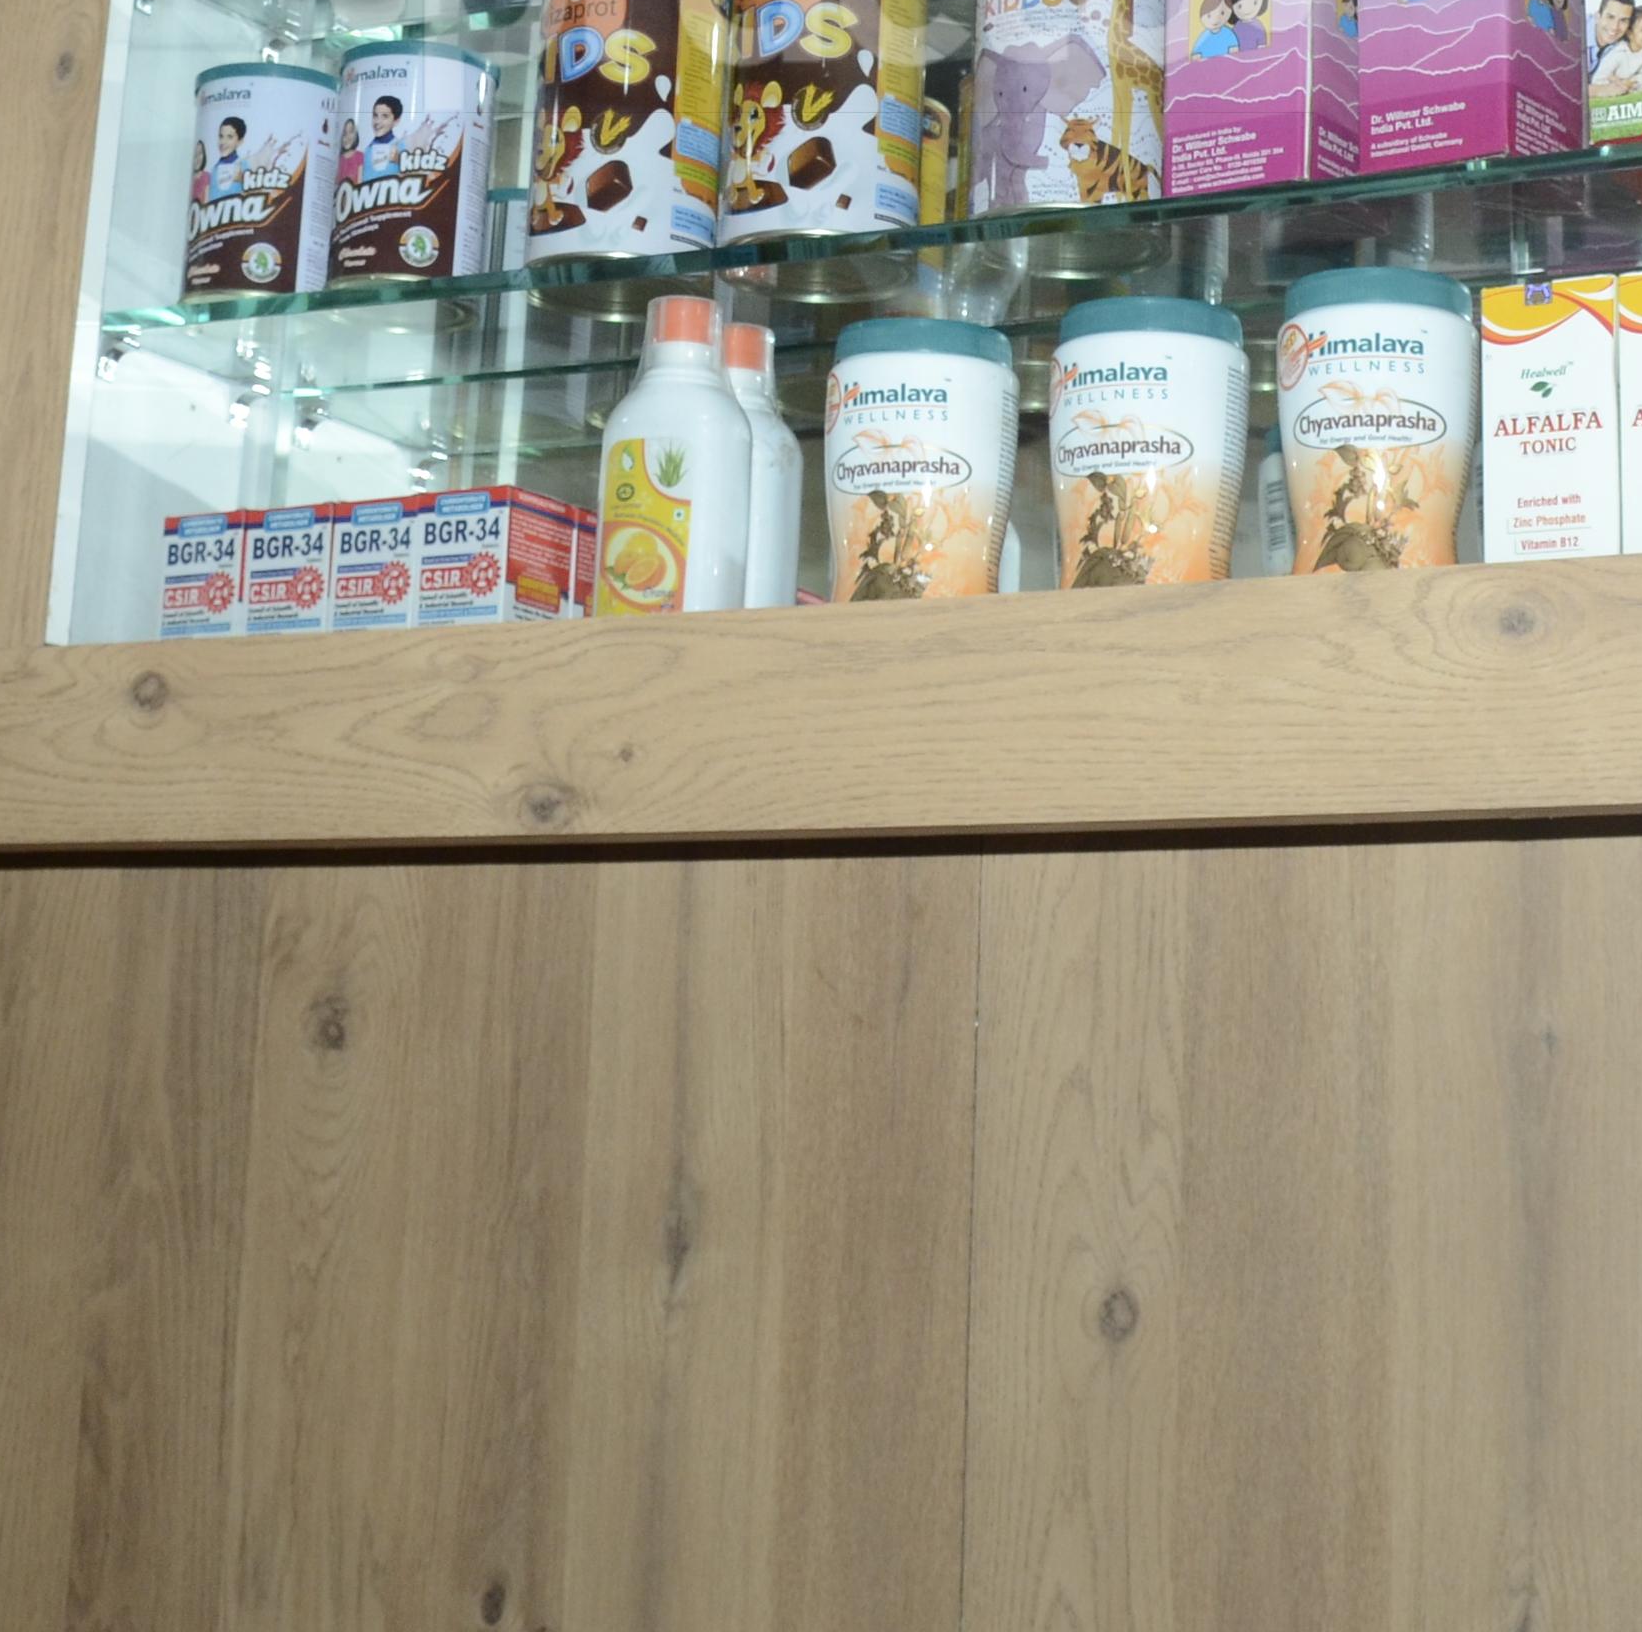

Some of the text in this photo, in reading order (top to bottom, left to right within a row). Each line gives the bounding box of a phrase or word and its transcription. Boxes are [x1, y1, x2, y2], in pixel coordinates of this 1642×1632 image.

[400, 149, 448, 172] kidz
[243, 168, 291, 190] kidz
[1308, 331, 1424, 357] Himalaya
[1064, 360, 1168, 391] Himalaya
[1309, 361, 1425, 376] WELLNESS
[843, 379, 948, 408] Himalaya
[1063, 388, 1169, 407] WELLNESS
[843, 409, 949, 425] WELLNESS
[1299, 410, 1436, 435] Chyavanaprasha
[1494, 411, 1602, 437] ALFALFA
[1058, 435, 1181, 465] Chyavanaprasha
[1520, 438, 1576, 455] TONIC
[837, 455, 960, 485] Chyavanaprasha
[339, 525, 411, 555] BGR-34
[424, 517, 500, 545] BGR-34
[167, 536, 235, 565] BGR-34
